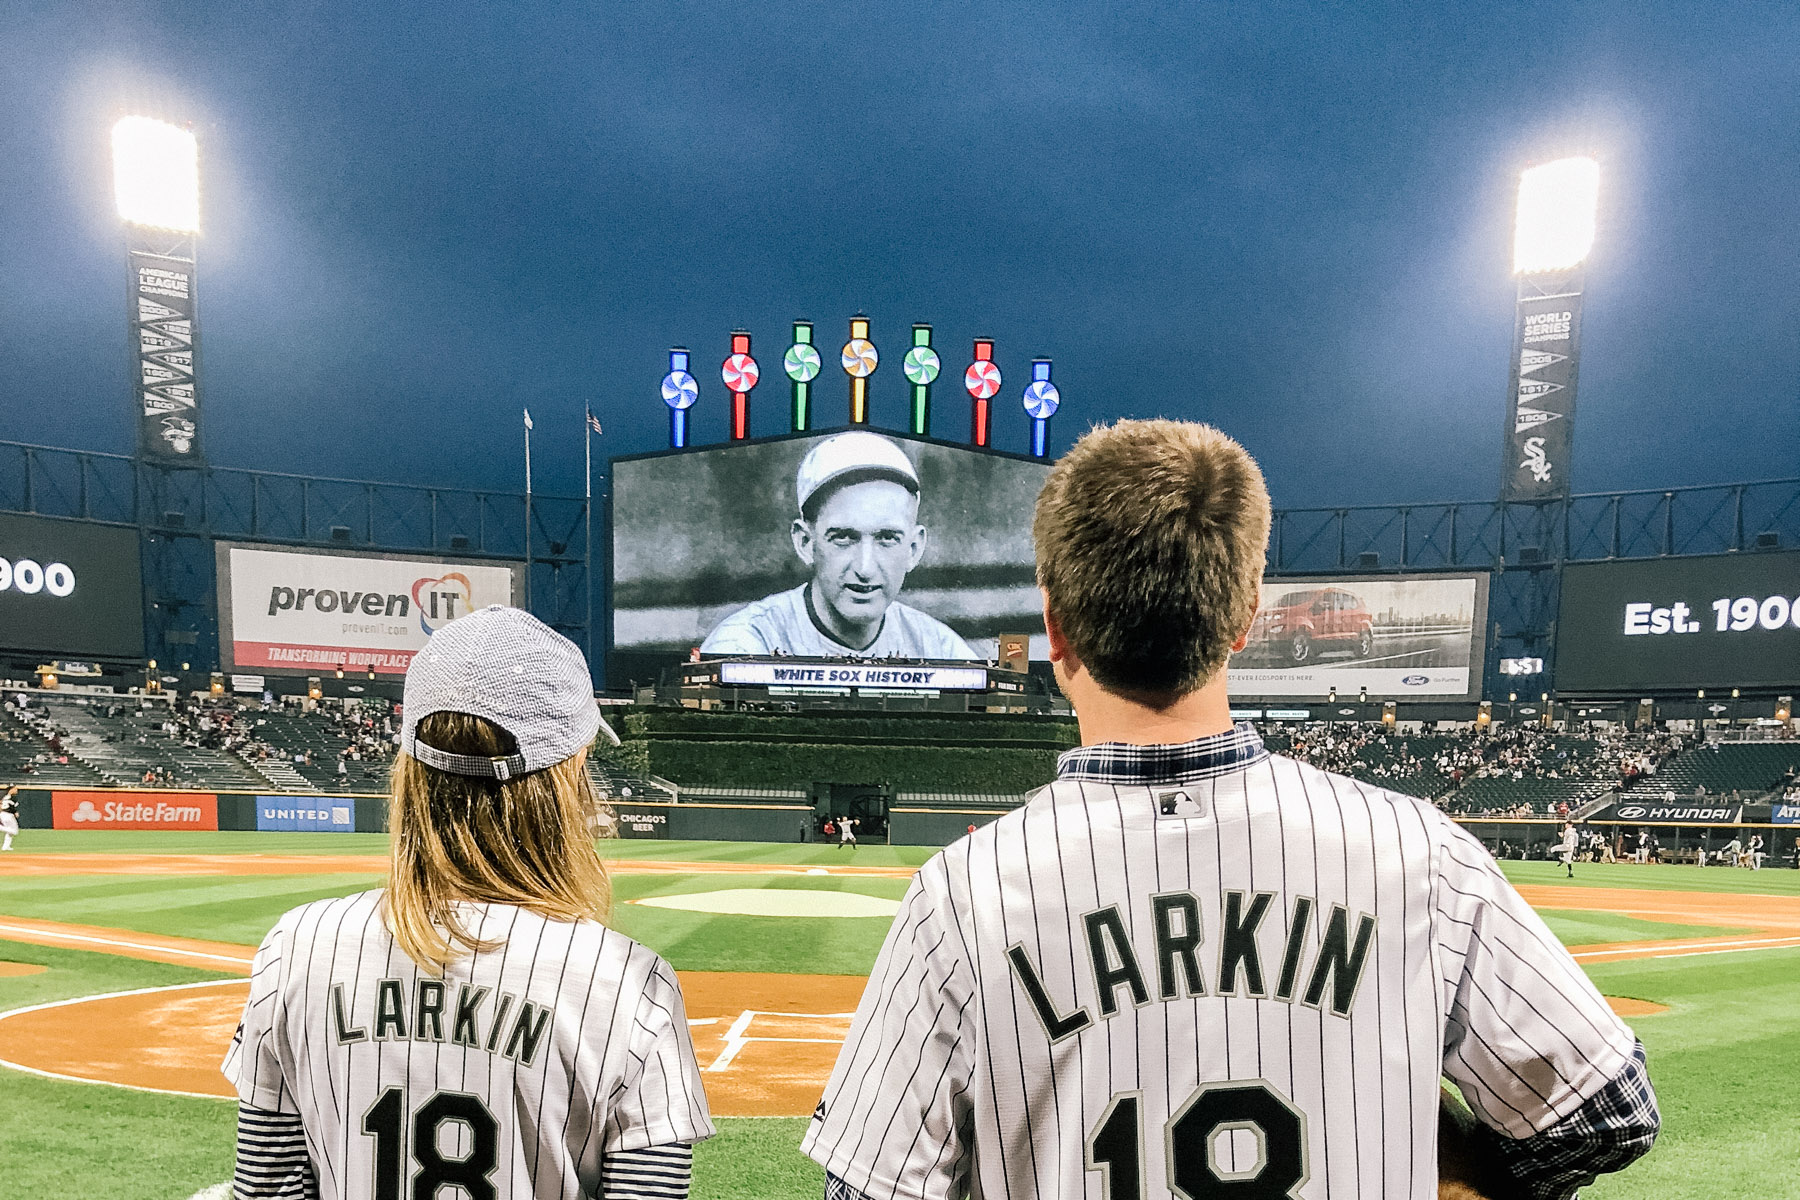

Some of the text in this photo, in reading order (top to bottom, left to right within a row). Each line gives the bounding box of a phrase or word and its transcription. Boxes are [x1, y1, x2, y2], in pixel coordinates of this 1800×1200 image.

[139, 268, 188, 281] AMERICAN
[140, 275, 188, 292] LEAGUE
[140, 285, 188, 299] CHAMPIONS
[1526, 312, 1572, 325] WORLD
[1525, 322, 1570, 336] SERIES
[1524, 334, 1569, 344] CHAMPIONS
[268, 585, 460, 620] proven IT
[1624, 601, 1700, 635] Est.
[268, 647, 347, 665] TRANSFORMING
[349, 651, 409, 668] WORKPLACE
[774, 668, 936, 684] WHITE SOX HISTORY
[264, 808, 329, 821] UNITED
[620, 814, 667, 824] CHICAGO'S
[1649, 807, 1732, 819] HYUNDAI
[632, 823, 654, 832] BEER
[1003, 889, 1379, 1046] LARKIN
[331, 977, 555, 1069] LARKIN
